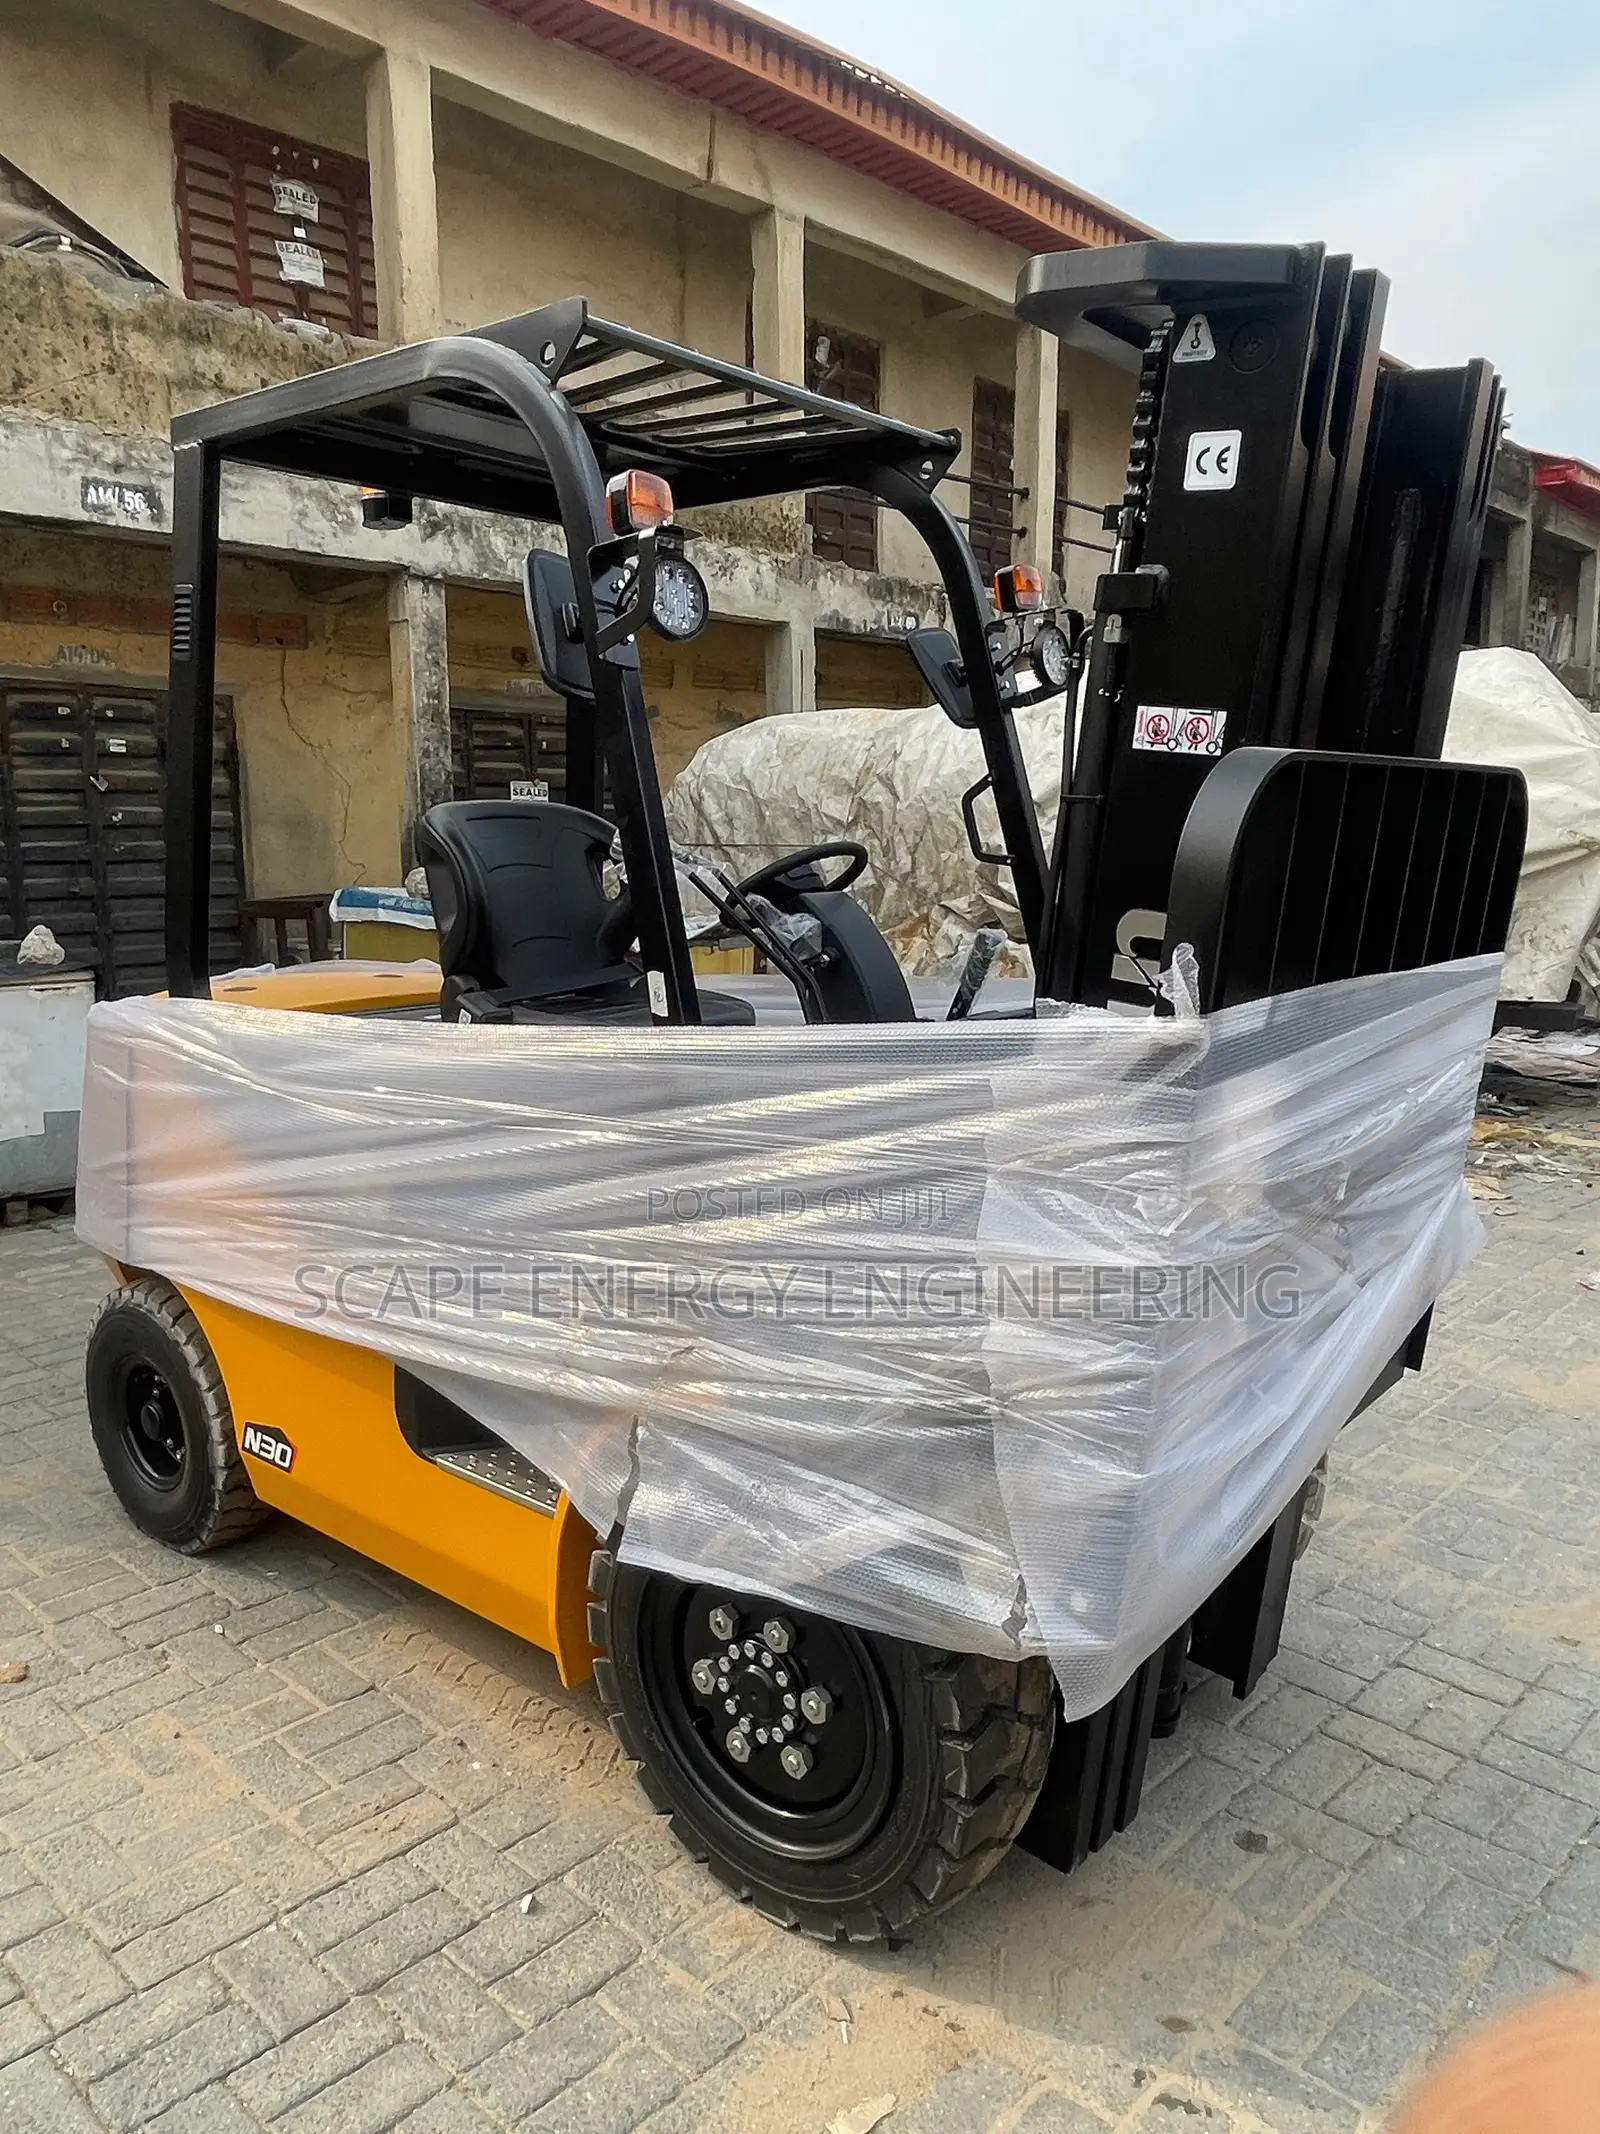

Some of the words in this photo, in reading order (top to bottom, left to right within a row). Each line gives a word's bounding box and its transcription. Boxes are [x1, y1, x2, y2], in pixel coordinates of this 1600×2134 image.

[1196, 445, 1231, 475] CE
[512, 787, 548, 798] SEALED
[244, 1426, 293, 1468] N30
